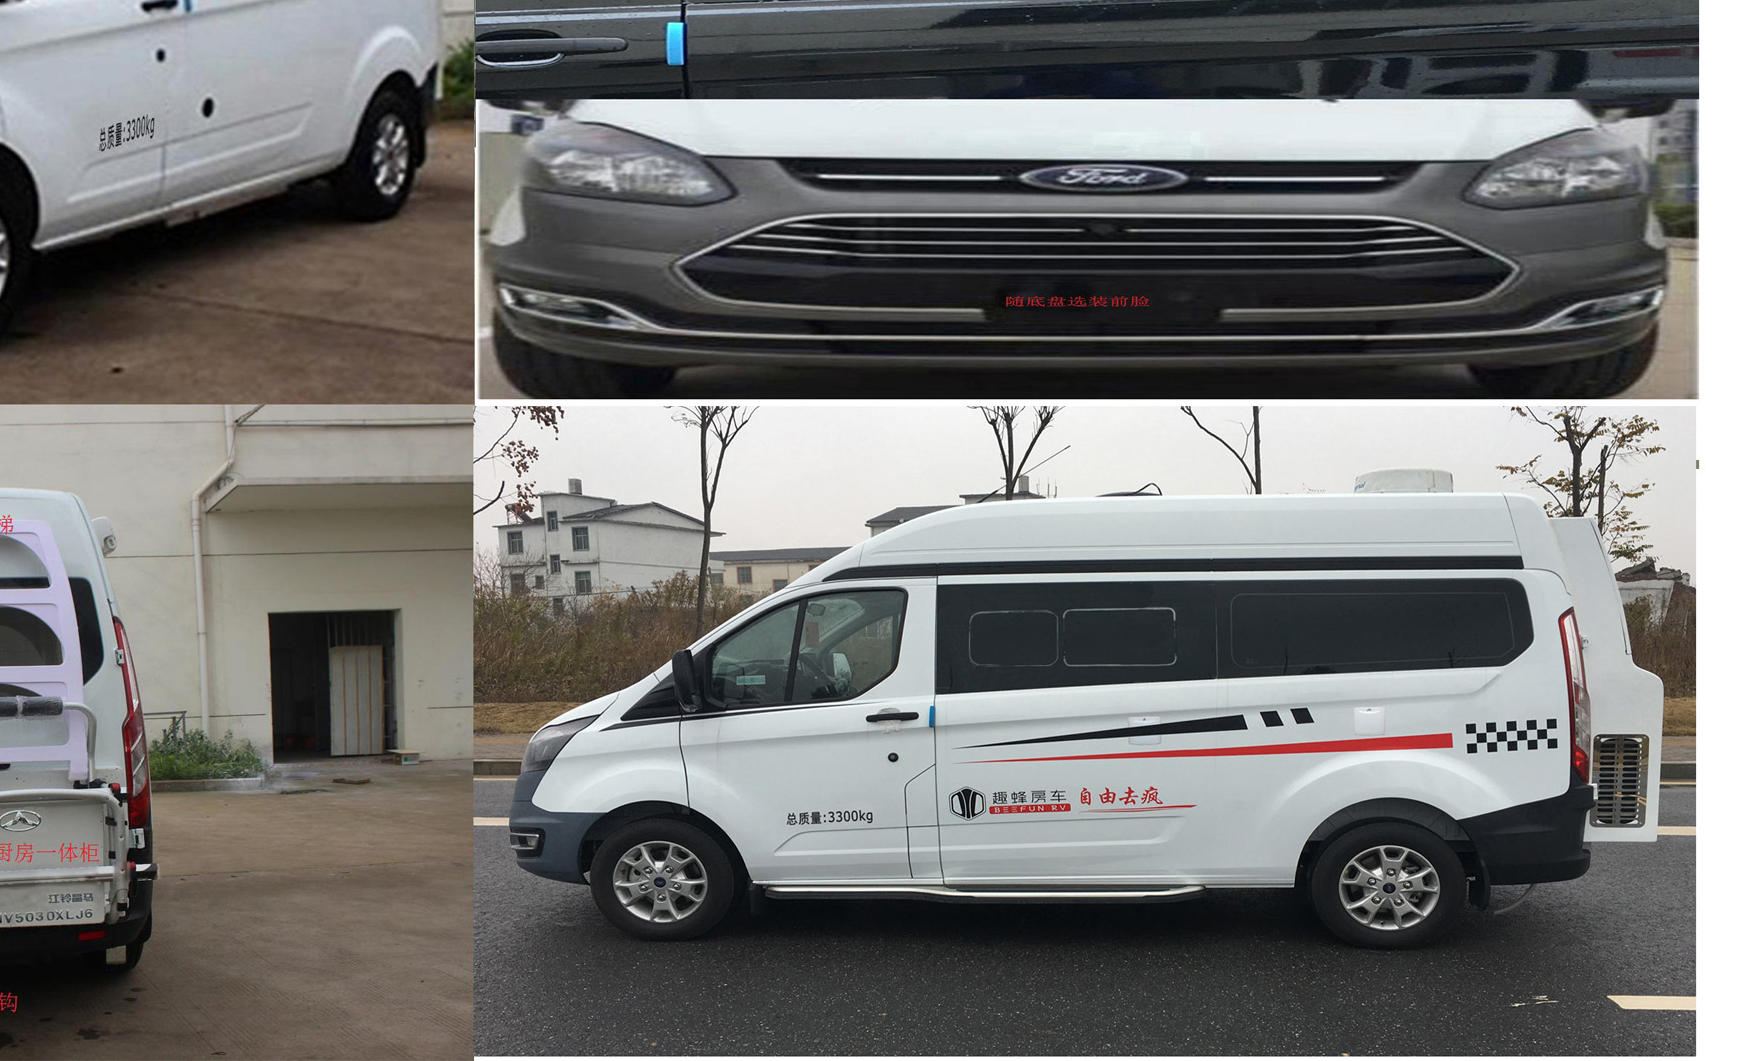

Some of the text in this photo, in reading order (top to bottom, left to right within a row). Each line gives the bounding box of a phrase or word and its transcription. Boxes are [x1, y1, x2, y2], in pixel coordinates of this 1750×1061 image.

[99, 114, 155, 152] 总质量:3300kg
[1058, 168, 1148, 185] Ford
[992, 789, 1067, 805] 趣蜂房车
[1080, 786, 1164, 806] 自由去疯
[1051, 804, 1067, 812] RV
[786, 808, 874, 826] 总质量:3300kg
